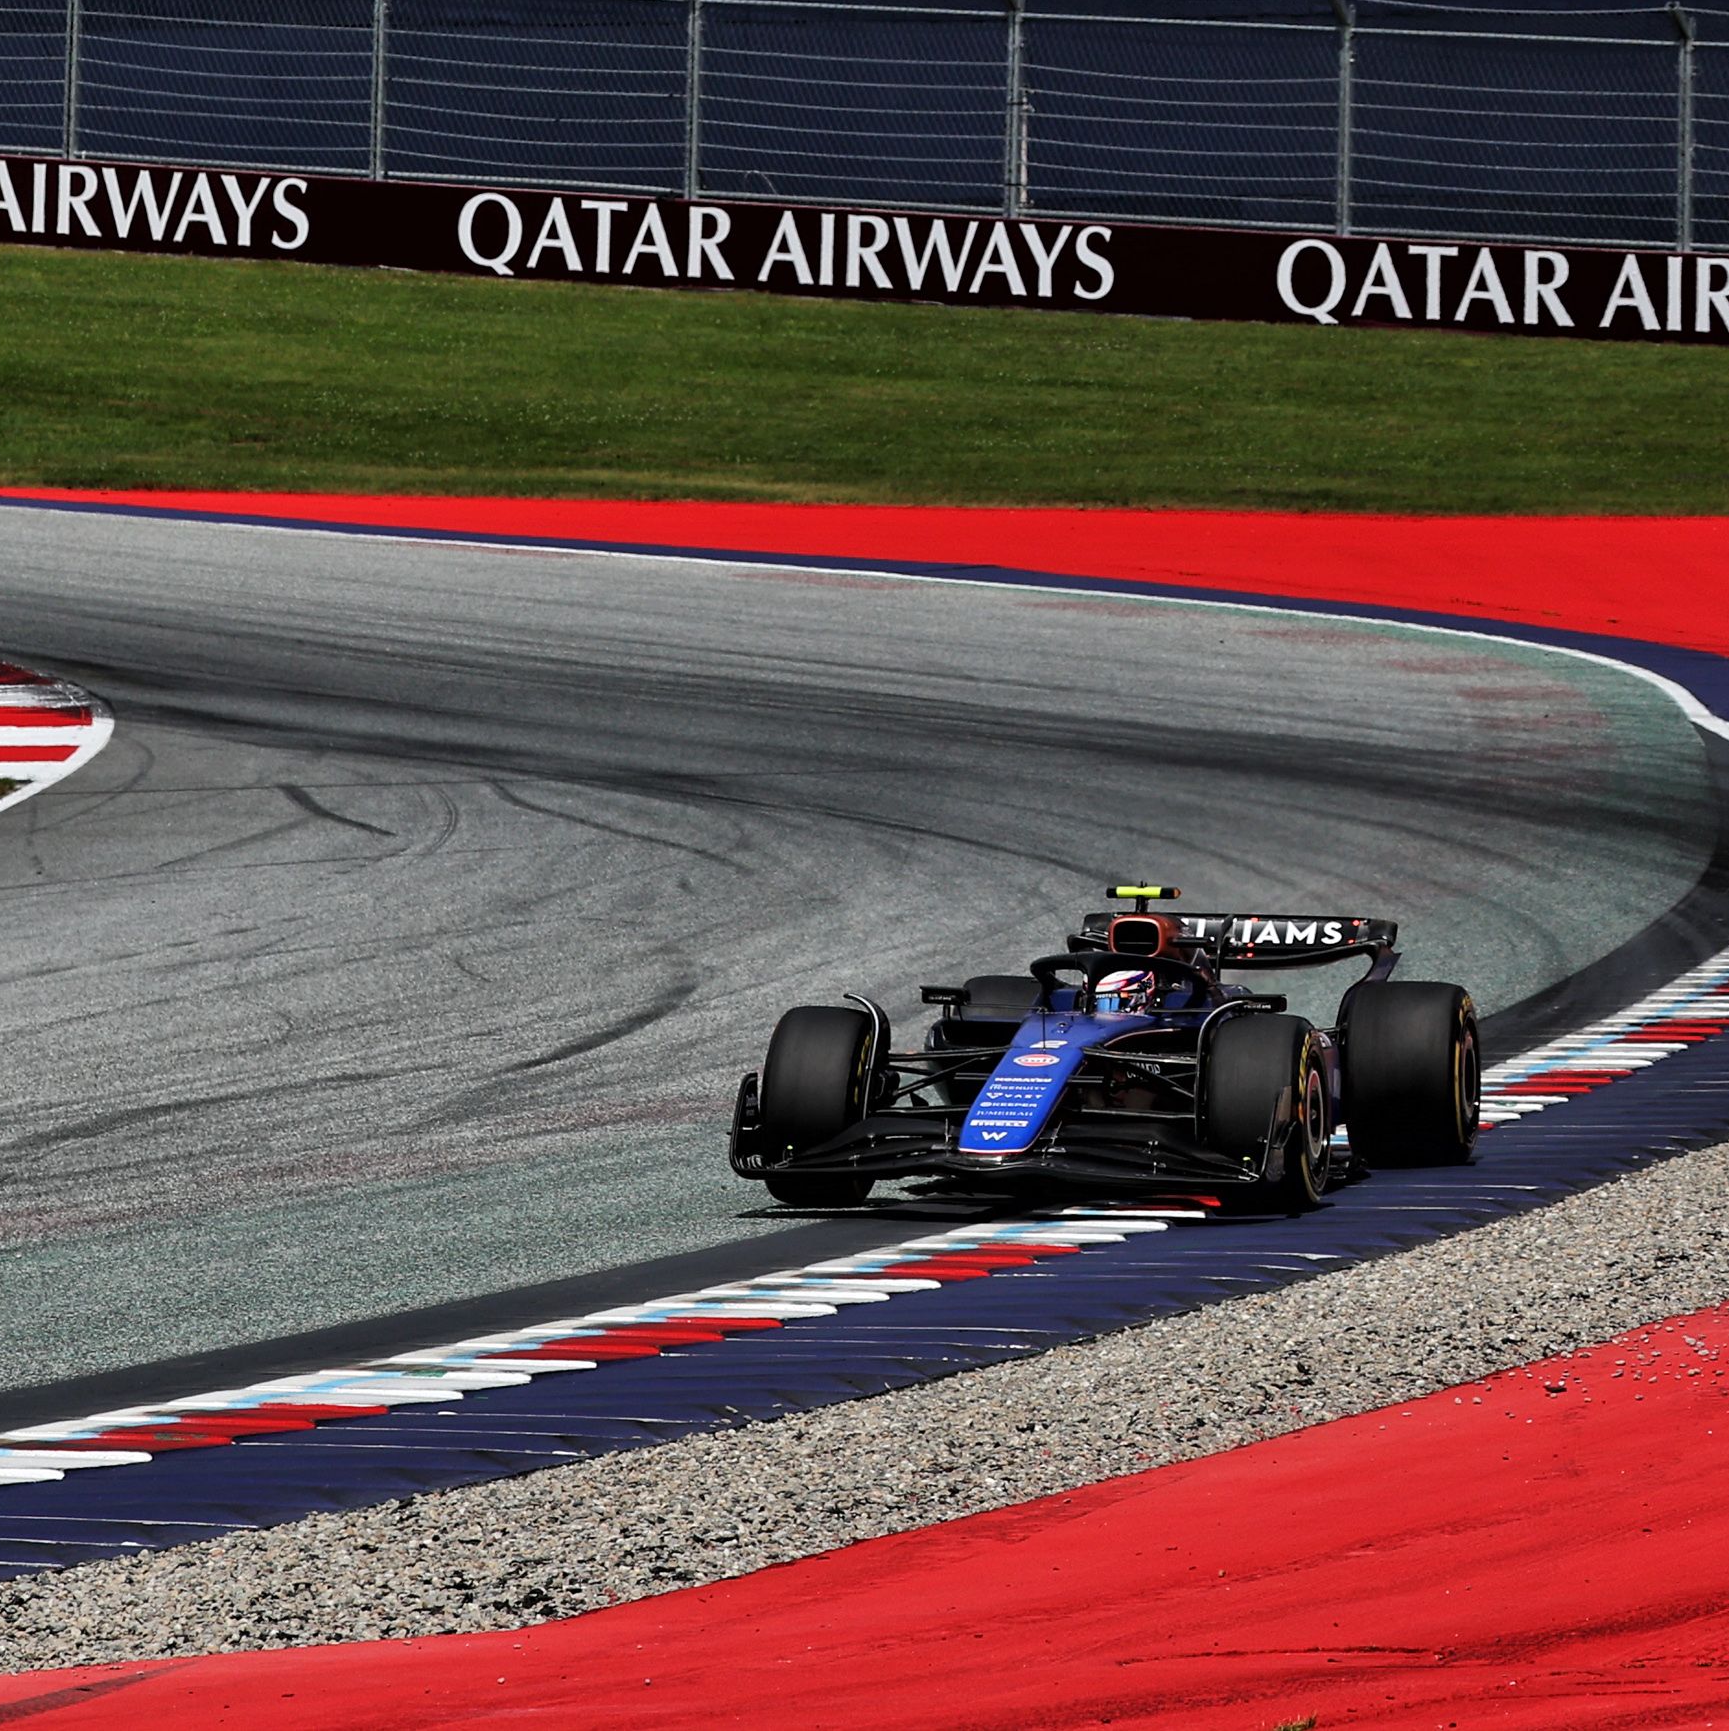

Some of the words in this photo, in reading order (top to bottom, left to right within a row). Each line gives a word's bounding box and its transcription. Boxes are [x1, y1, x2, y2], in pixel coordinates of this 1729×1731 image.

[457, 192, 736, 280] QATAR
[757, 210, 1116, 300] AIRWAYS
[1276, 239, 1575, 327] QATAR
